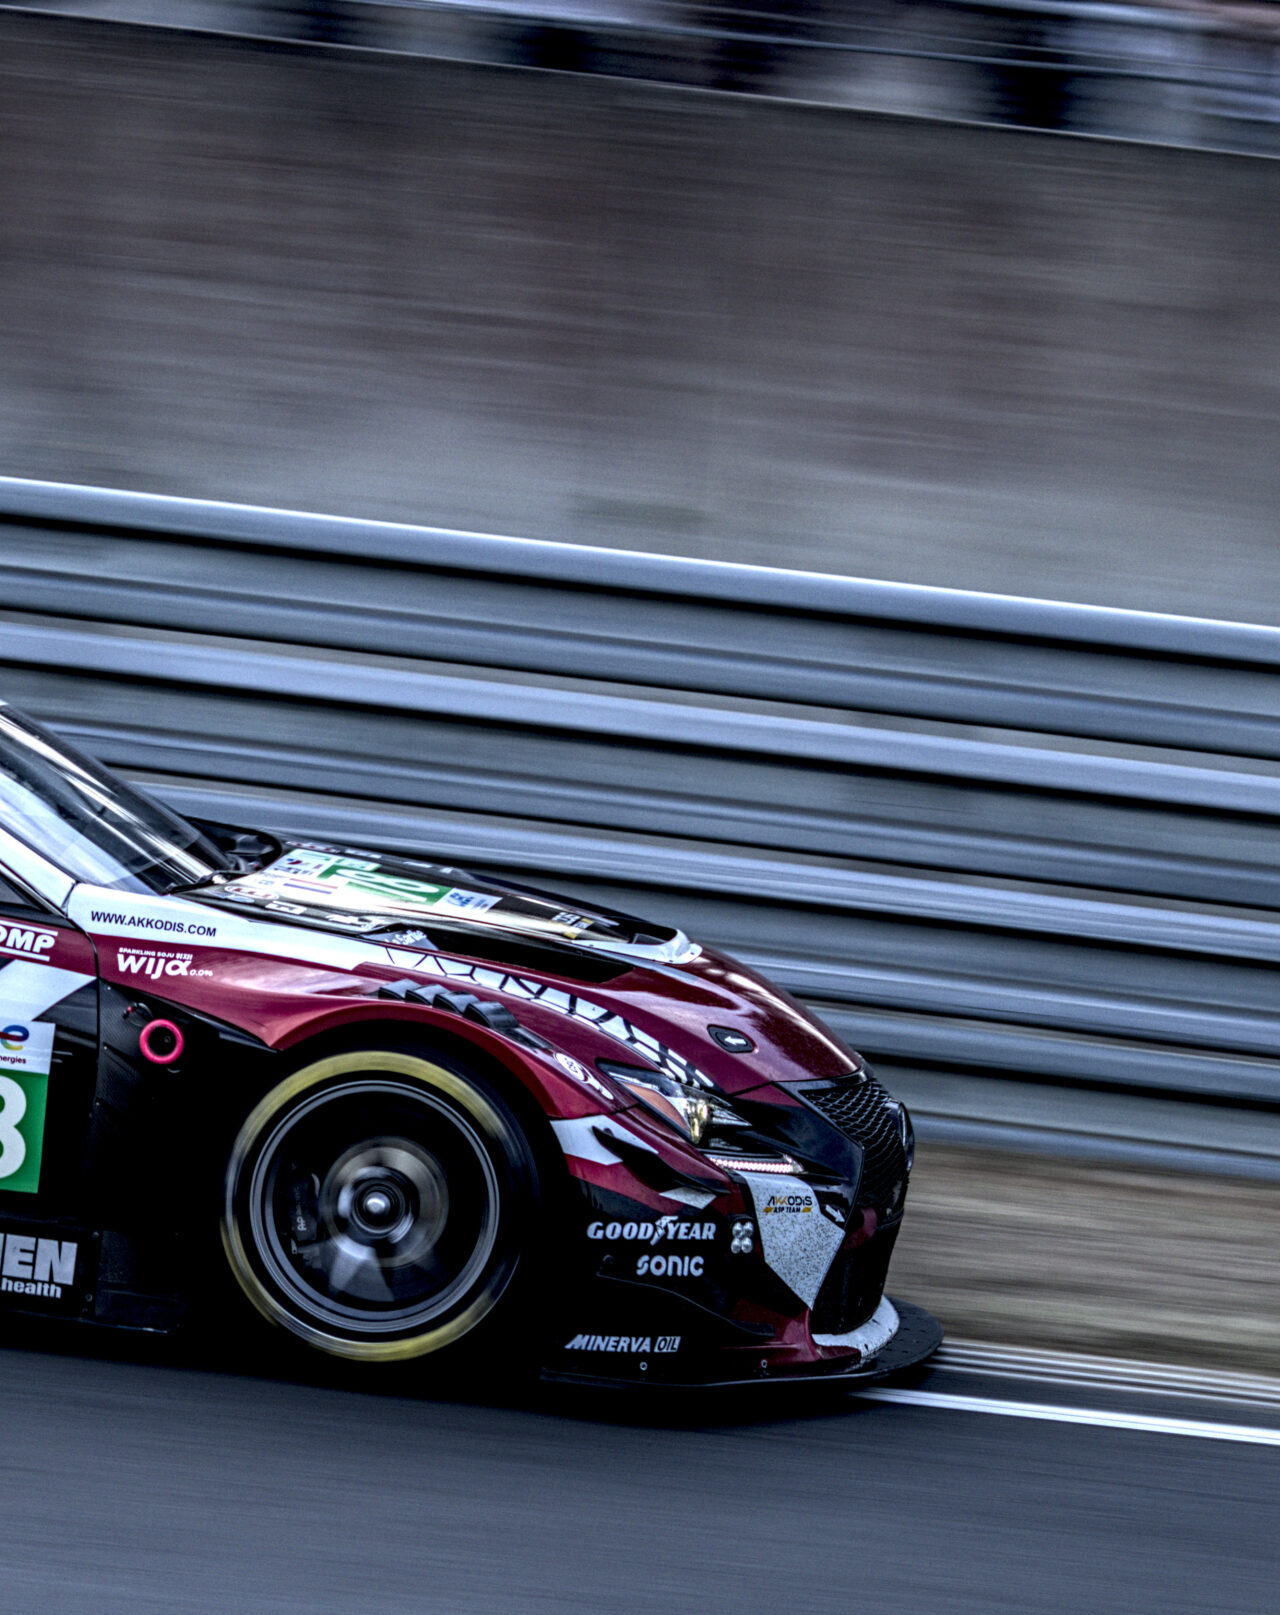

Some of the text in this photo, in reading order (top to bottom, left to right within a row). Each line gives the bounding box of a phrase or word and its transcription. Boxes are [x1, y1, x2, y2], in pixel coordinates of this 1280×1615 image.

[91, 911, 217, 937] WWW.AKKODIS.COM
[636, 1254, 704, 1277] SONIC
[564, 1334, 681, 1353] MINERVA OIL
